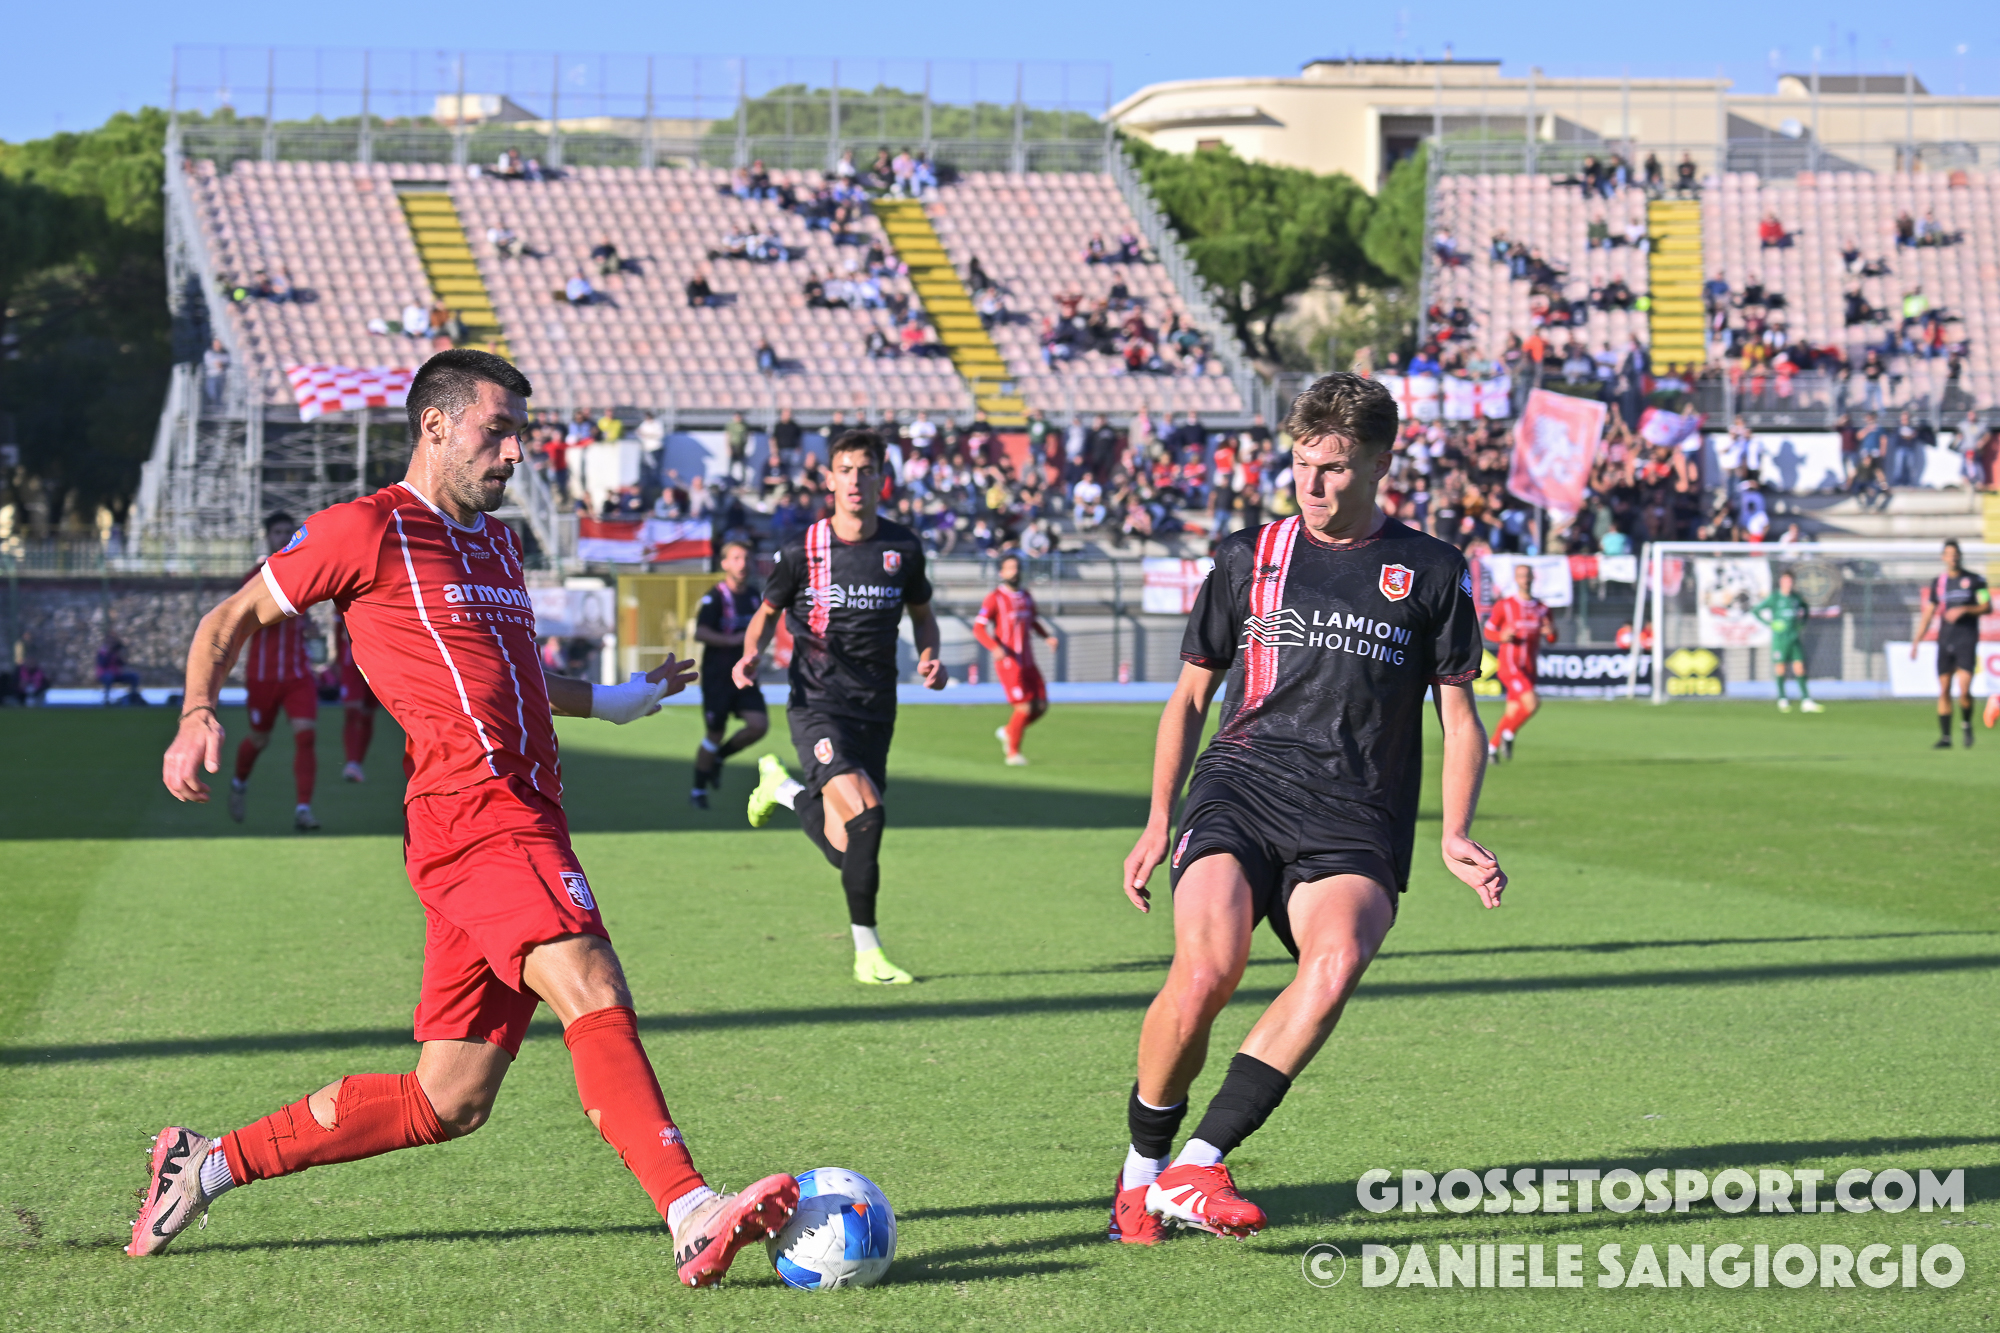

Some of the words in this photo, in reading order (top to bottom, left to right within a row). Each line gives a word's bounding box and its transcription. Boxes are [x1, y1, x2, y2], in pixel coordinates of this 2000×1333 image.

[848, 584, 904, 598] LAMION
[847, 597, 902, 610] HOLDI
[1312, 610, 1412, 646] LAMIONI
[1308, 631, 1405, 666] HOLDING
